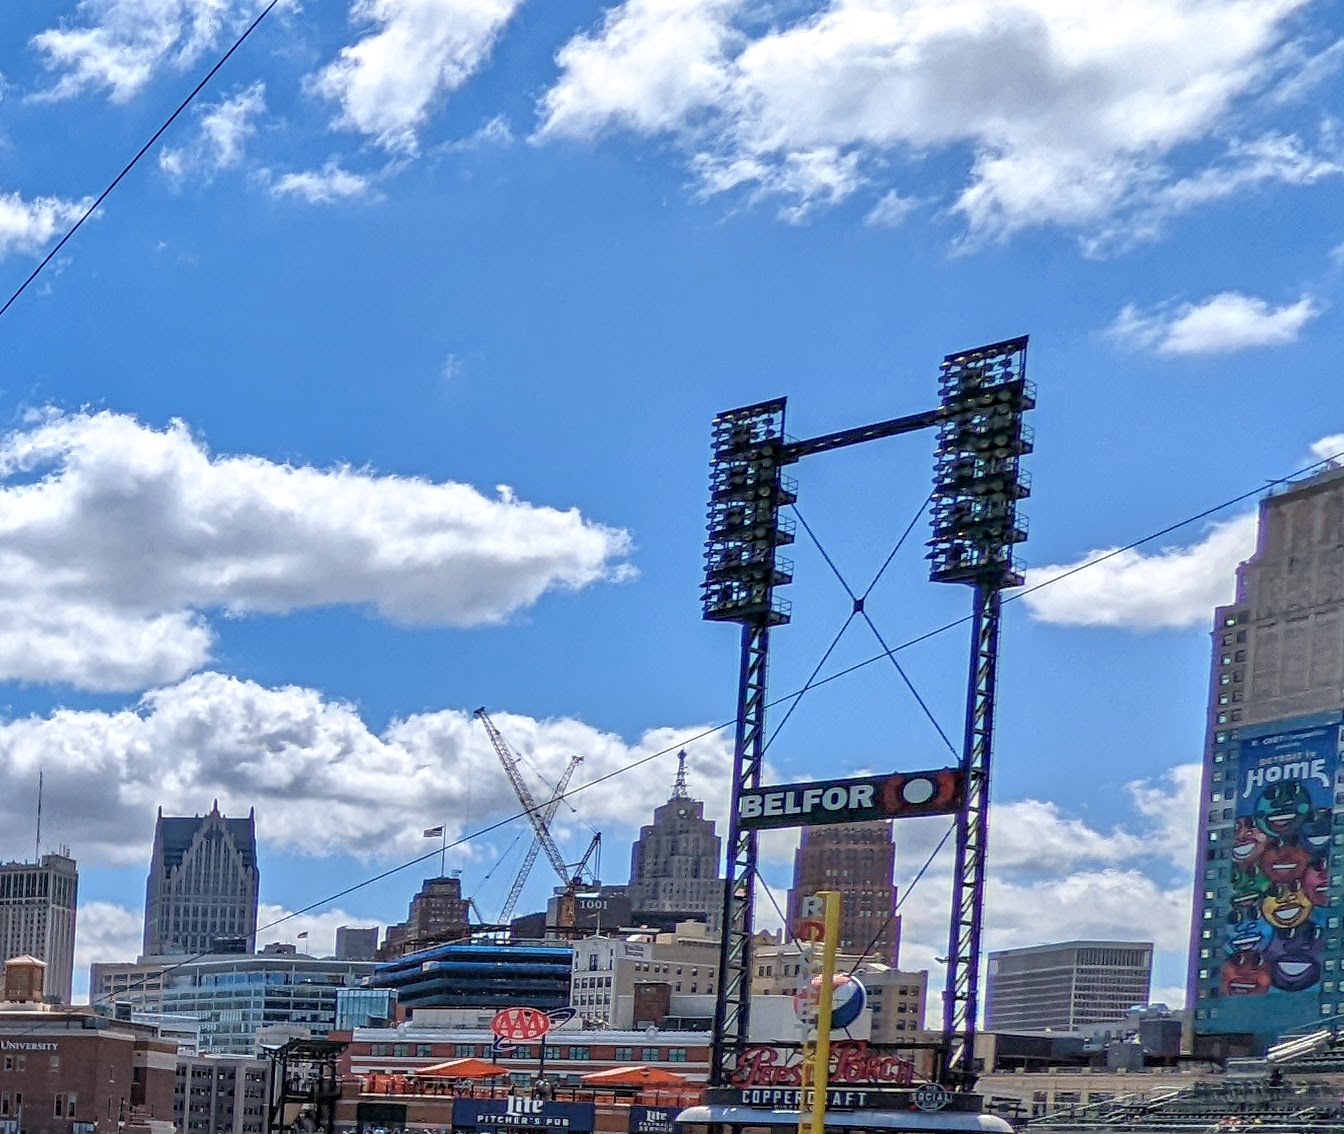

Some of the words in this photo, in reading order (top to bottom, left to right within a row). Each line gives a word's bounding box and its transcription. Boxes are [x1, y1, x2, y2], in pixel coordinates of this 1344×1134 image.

[1242, 758, 1330, 799] HOME
[740, 783, 874, 819] BELFOR
[0, 1040, 59, 1051] UNIVERSITY
[505, 1095, 544, 1116] Lite
[476, 1114, 541, 1126] PITCHER'S
[545, 1118, 570, 1127] PUB
[646, 1110, 668, 1123] Lite
